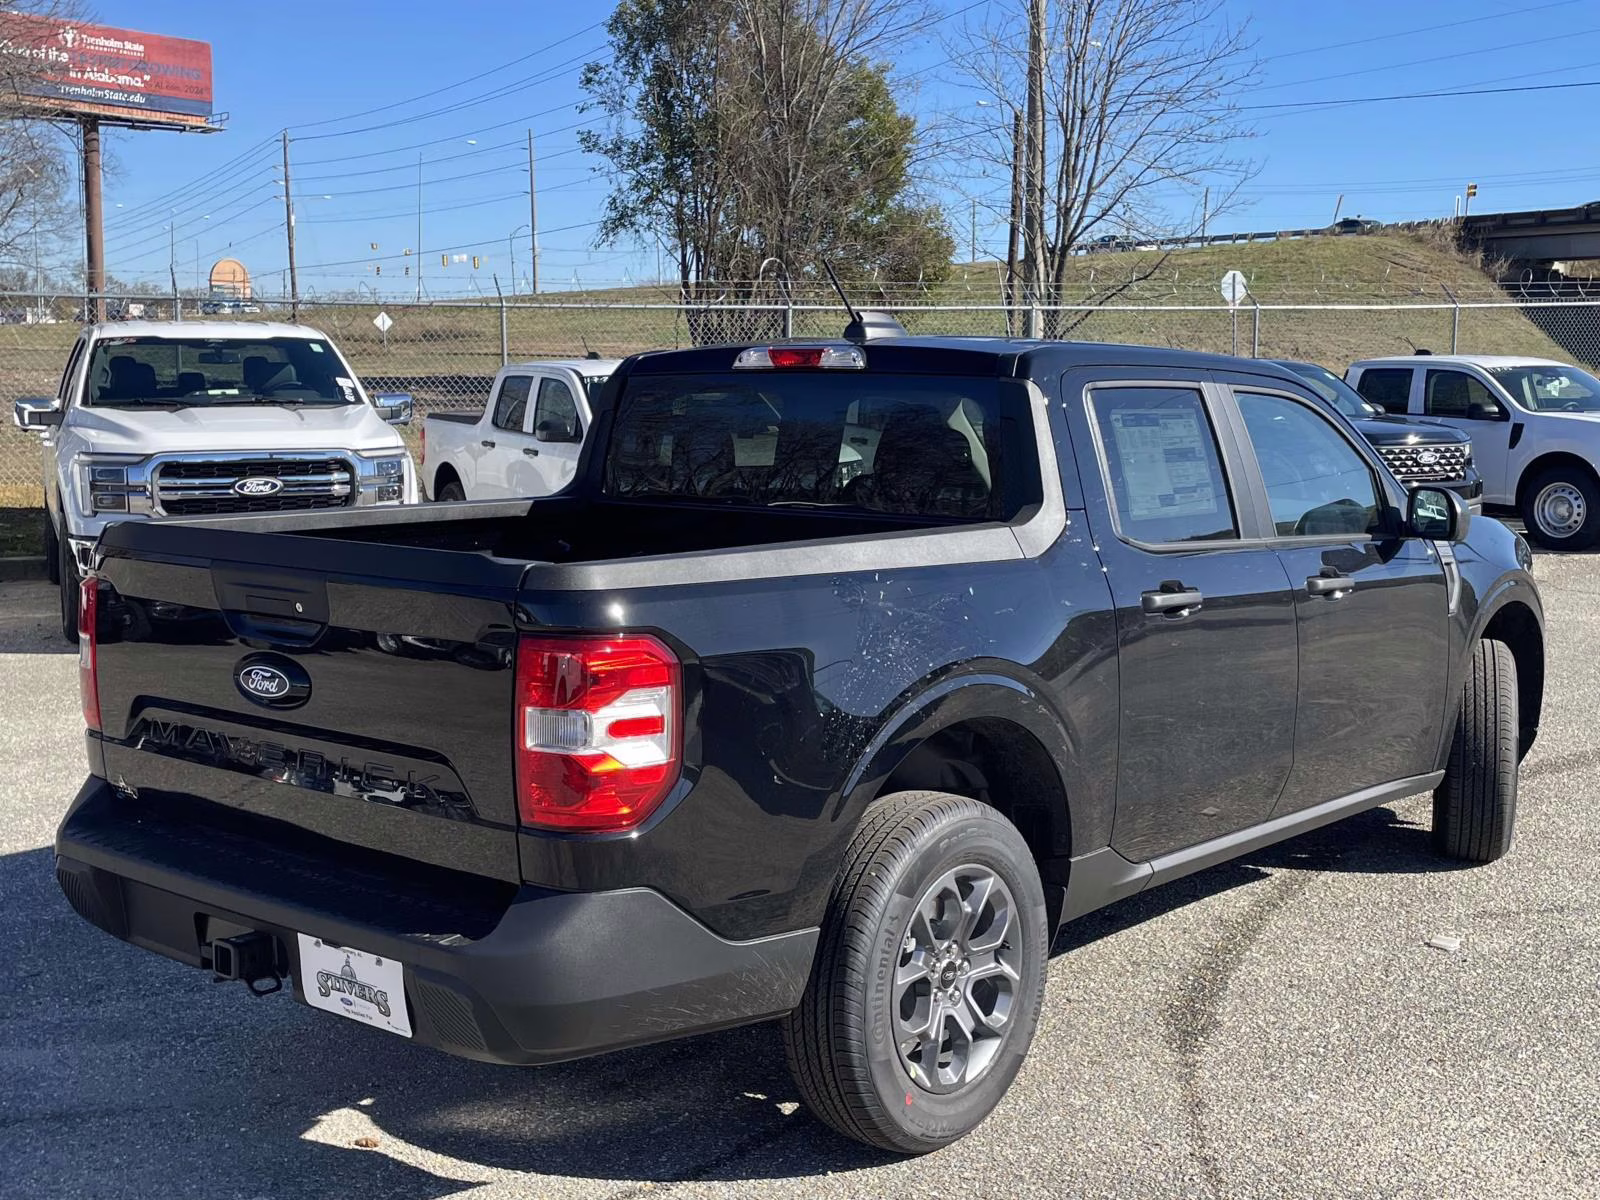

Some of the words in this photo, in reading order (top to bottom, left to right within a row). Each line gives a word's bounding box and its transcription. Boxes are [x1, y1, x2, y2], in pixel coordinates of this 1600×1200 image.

[81, 34, 123, 49] Trenholm
[124, 40, 145, 51] State
[244, 481, 272, 492] Ford
[249, 669, 279, 693] Ford
[316, 970, 391, 1017] STIVERS
